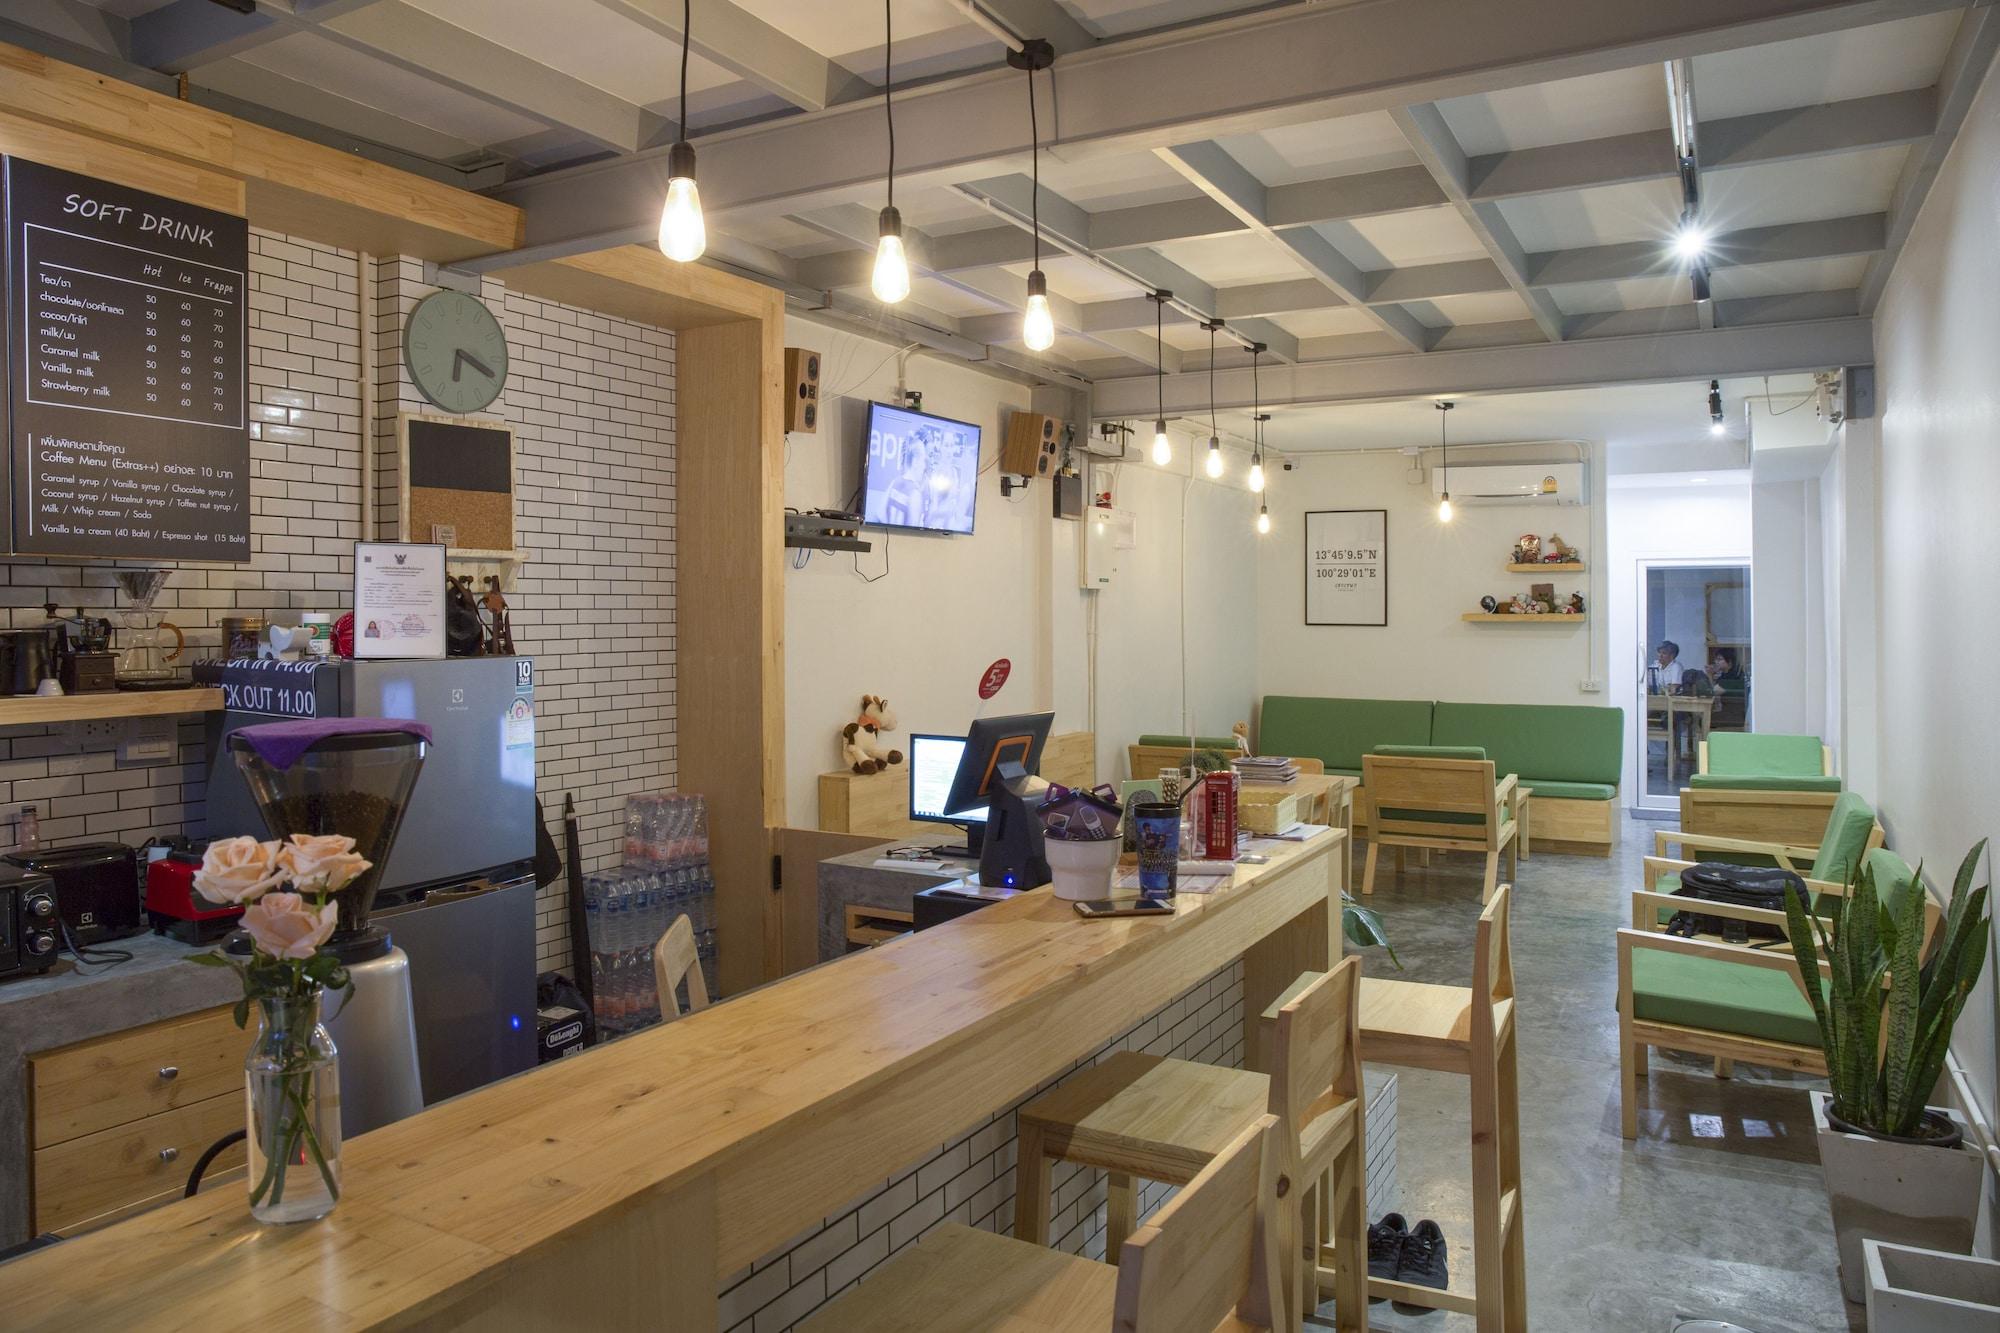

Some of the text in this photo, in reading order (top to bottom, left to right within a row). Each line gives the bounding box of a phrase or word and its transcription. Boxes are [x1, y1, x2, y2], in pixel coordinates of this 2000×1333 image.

[63, 194, 214, 247] SOFT DRINK
[143, 264, 233, 295] Hot Ice Frappe
[146, 295, 157, 304] 50
[181, 302, 191, 311] 60
[214, 309, 223, 317] 70
[146, 311, 157, 320] 50
[181, 319, 191, 327] 60
[214, 324, 223, 333] 70
[146, 328, 157, 336] 50
[181, 335, 191, 343] 60
[214, 340, 223, 348] 70
[41, 344, 223, 380] Caramel milk 50 60 70
[147, 345, 157, 353] 40
[181, 350, 191, 359] 50
[214, 356, 223, 364] 60
[41, 361, 72, 374] Vanilla
[77, 367, 94, 377] milk
[146, 377, 157, 385] 50
[214, 387, 223, 395] 70
[42, 379, 89, 395] Strawberry
[93, 386, 110, 396] milk
[146, 393, 157, 401] 50
[214, 403, 223, 411] 70
[41, 451, 74, 464] Coffee
[79, 456, 107, 467] Menu
[112, 458, 159, 473] (Extras++)
[202, 467, 212, 477] 10
[217, 471, 233, 479] บาท
[41, 473, 75, 483] Caramel
[79, 478, 99, 488] syrup
[112, 479, 138, 488] Vanilla
[142, 484, 160, 492] syrup
[172, 484, 205, 495] Chocolate
[208, 489, 226, 498] syrup
[41, 489, 74, 498] Coconut
[78, 494, 99, 502] syrup
[111, 494, 143, 504] Hazelnut
[146, 499, 165, 507] syrup
[177, 499, 197, 508] Toffee
[213, 504, 231, 513] syrup
[41, 504, 59, 513] Milk
[72, 506, 94, 517] Whip
[133, 510, 152, 519] Soda
[42, 524, 69, 533] Vanilla
[74, 526, 84, 534] Ice
[115, 528, 128, 537] (40
[132, 529, 150, 538] Baht)
[162, 531, 191, 540] Espresso
[194, 533, 208, 541] shot
[215, 534, 226, 542] (15
[230, 535, 246, 544] Baht)
[518, 662, 530, 677] 10
[244, 686, 273, 710] OUT
[278, 689, 314, 714] 11.00
